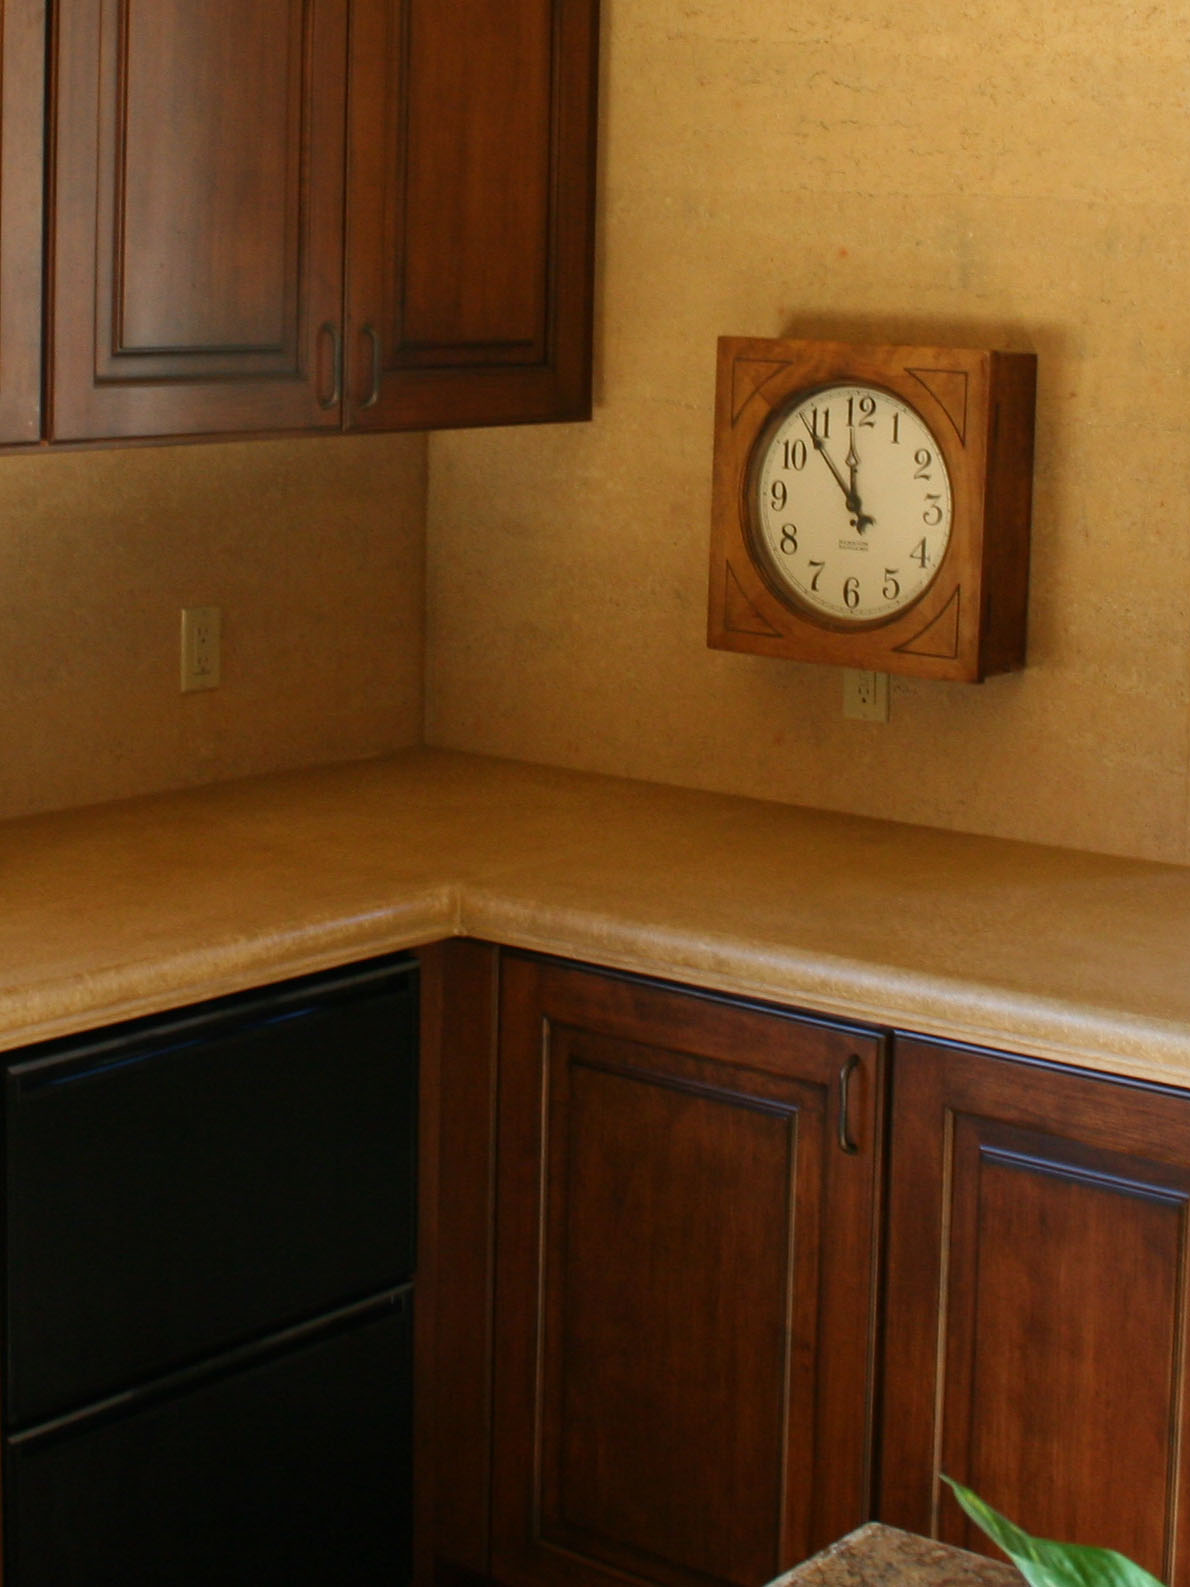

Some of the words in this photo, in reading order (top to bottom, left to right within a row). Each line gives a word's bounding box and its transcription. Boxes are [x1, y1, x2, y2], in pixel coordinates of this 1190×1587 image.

[811, 406, 830, 438] 11
[846, 396, 877, 428] 12
[891, 411, 900, 444] 1
[782, 438, 807, 471] 10
[913, 448, 932, 481] 2
[770, 480, 788, 511] 9
[923, 493, 943, 526] 3
[780, 523, 797, 555] 8
[910, 537, 931, 568] 4
[808, 560, 826, 592] 7
[882, 569, 900, 601] 5
[843, 577, 860, 609] 6
